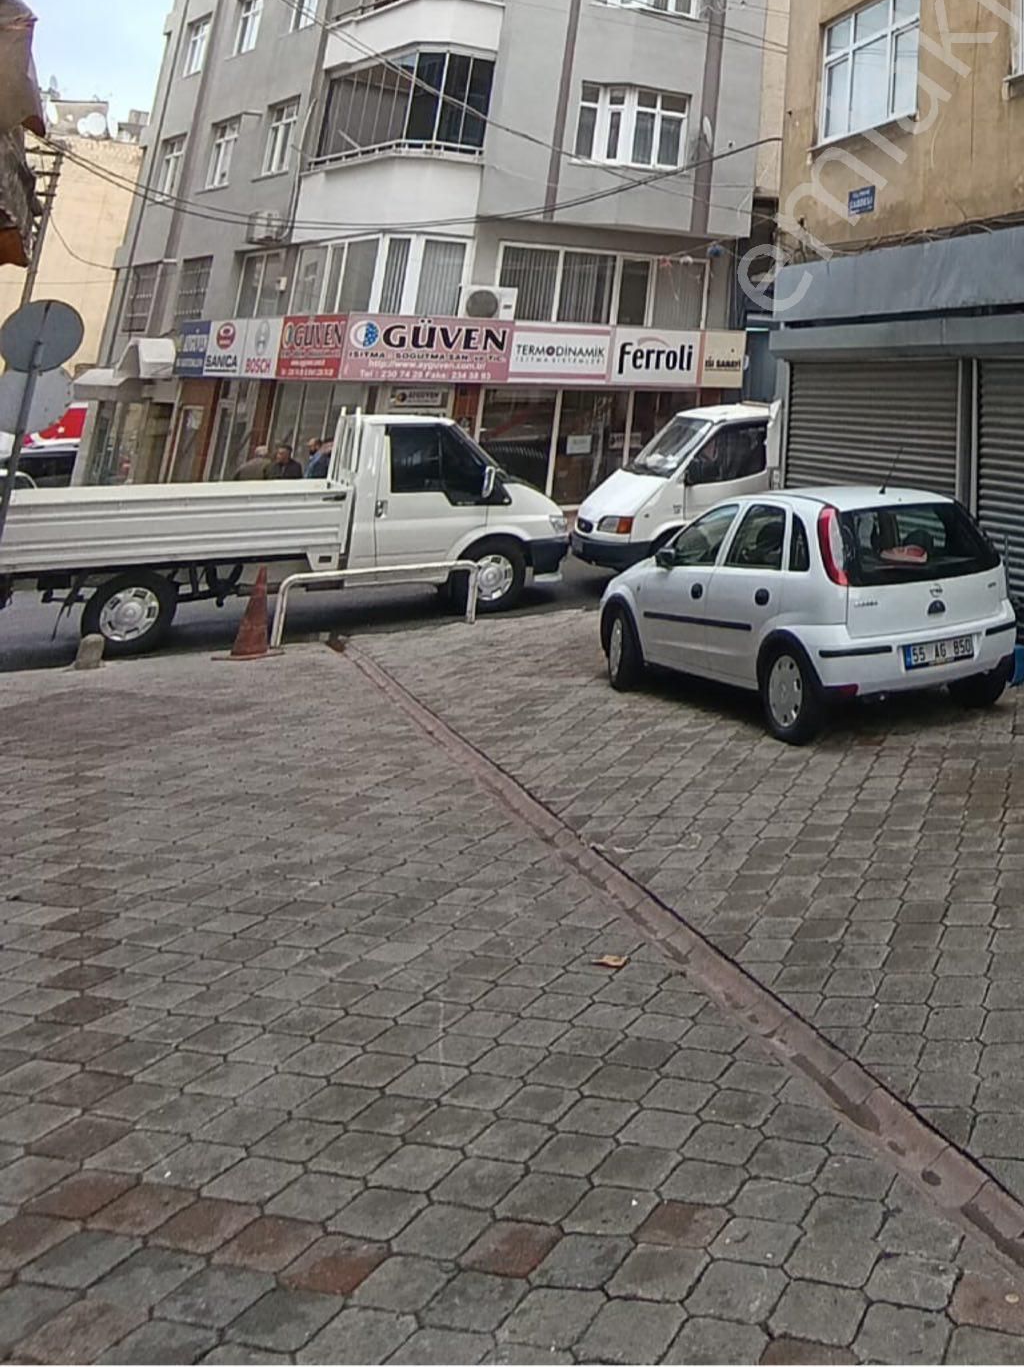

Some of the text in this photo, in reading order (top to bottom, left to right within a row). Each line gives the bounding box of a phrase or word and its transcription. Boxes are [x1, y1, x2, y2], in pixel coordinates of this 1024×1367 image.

[382, 319, 508, 352] GÜVEN
[515, 342, 605, 358] TERMODİNAMİK
[205, 353, 238, 368] SANICA
[244, 357, 272, 374] BOSCH
[912, 646, 926, 662] 55
